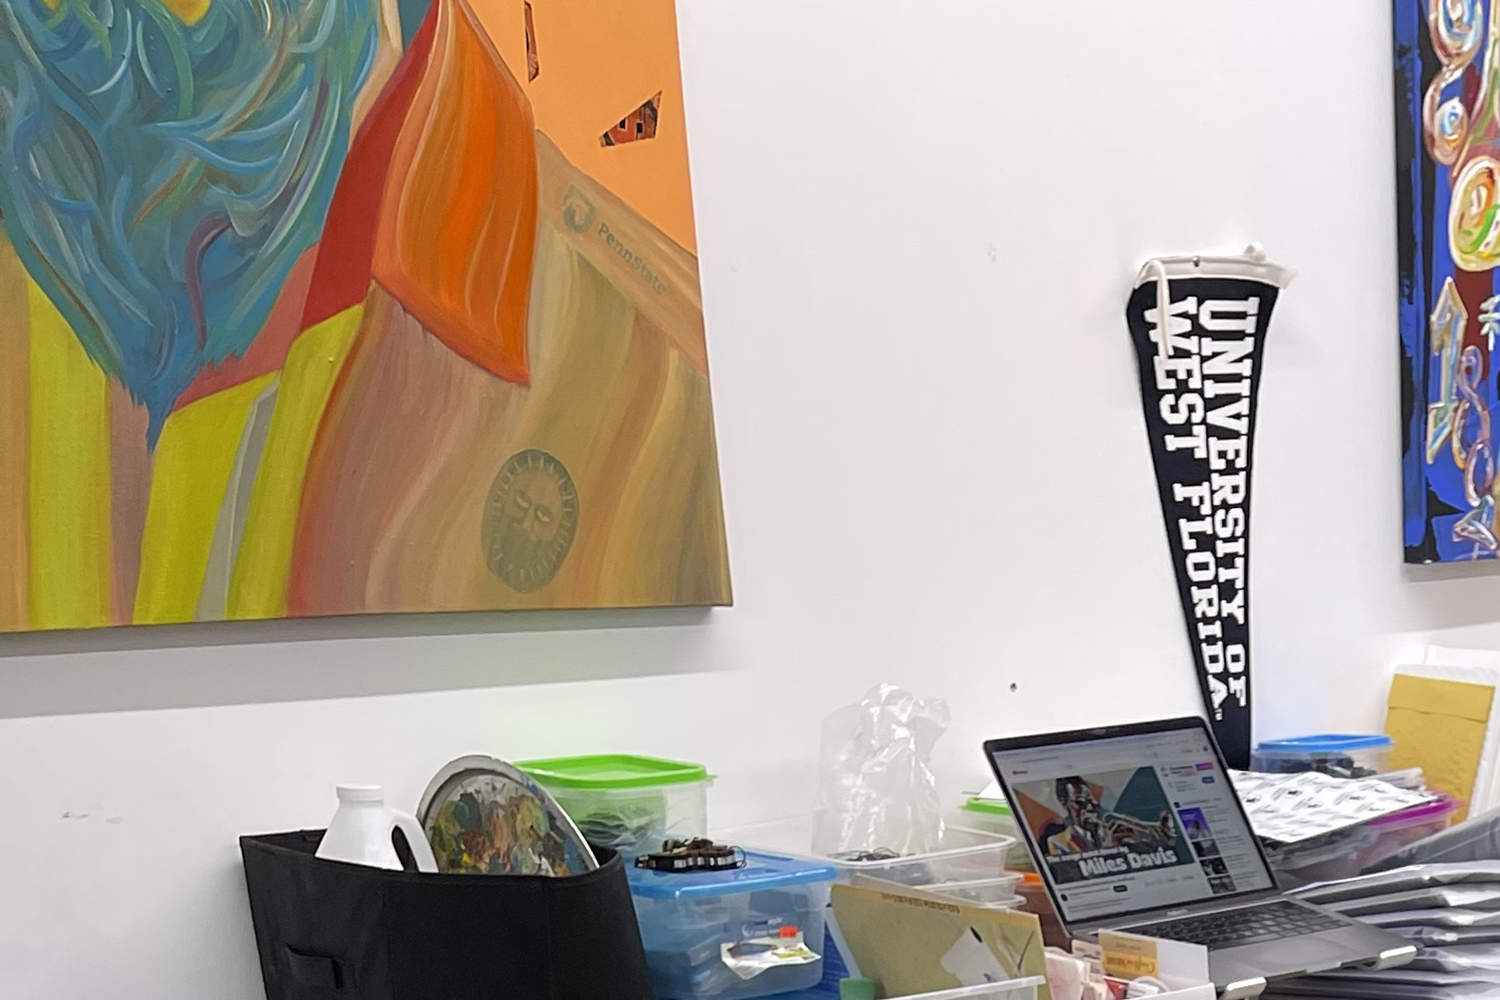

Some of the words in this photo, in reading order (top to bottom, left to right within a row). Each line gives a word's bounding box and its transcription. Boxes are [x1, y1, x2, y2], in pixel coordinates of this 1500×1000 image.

[598, 222, 667, 294] PennState
[1143, 296, 1207, 458] WEST
[1199, 296, 1260, 625] UNIVERSITY
[1173, 482, 1228, 709] FLORIDA
[1226, 643, 1246, 706] OF
[1078, 854, 1128, 877] Miles
[1127, 846, 1178, 869] Davis
